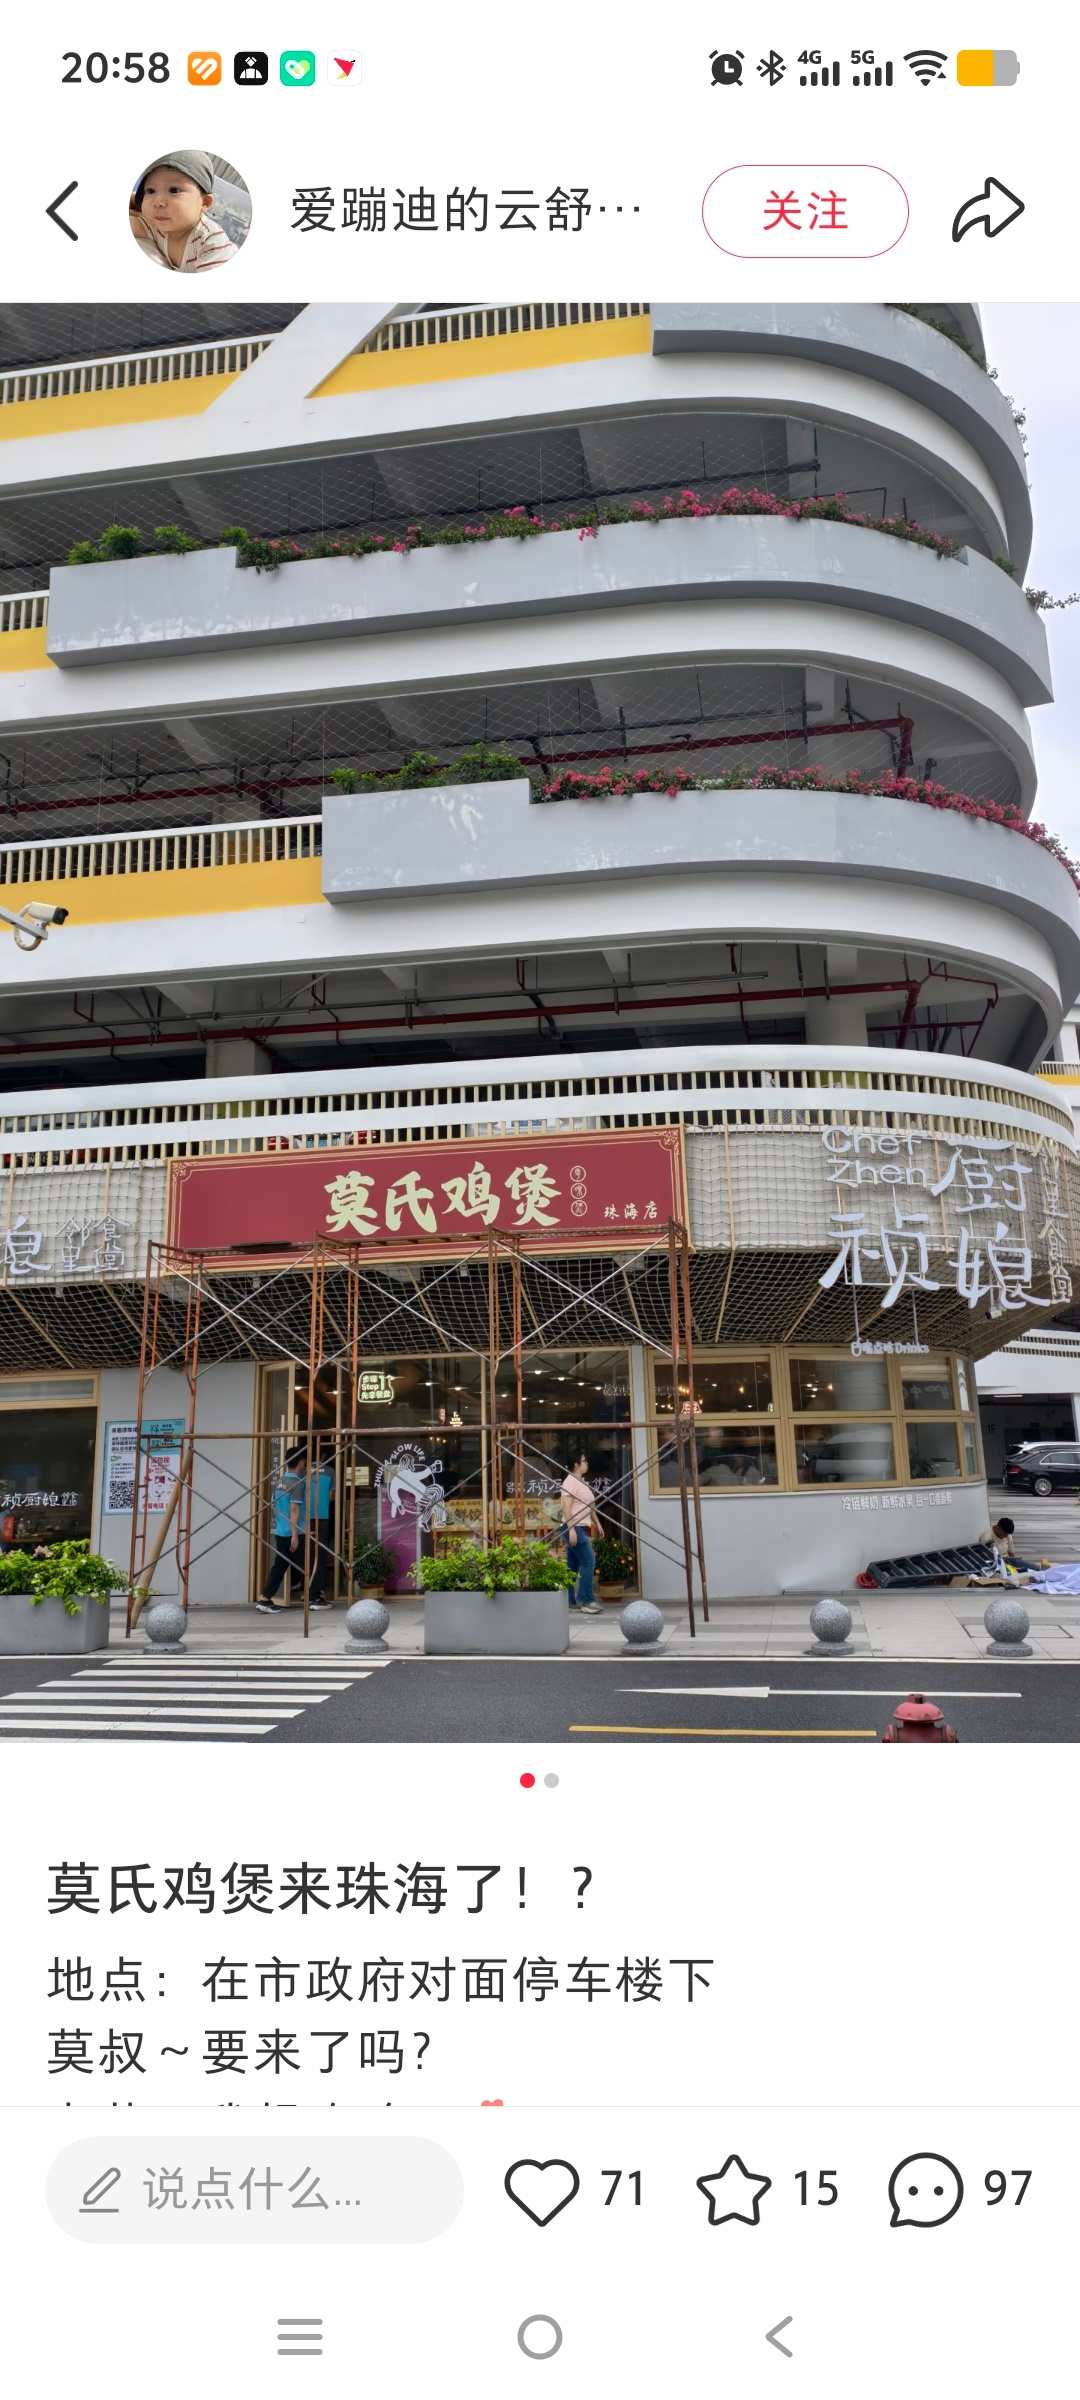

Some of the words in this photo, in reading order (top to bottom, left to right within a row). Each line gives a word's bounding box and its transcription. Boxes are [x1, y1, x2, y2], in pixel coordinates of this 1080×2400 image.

[822, 1125, 926, 1156] Chef
[826, 1158, 928, 1189] Zhen
[324, 1160, 562, 1237] 莫氏鸡煲
[604, 1200, 658, 1220] 珠海店
[361, 1383, 379, 1392] Step
[841, 1496, 879, 1511] 冷链鲜奶
[881, 1494, 914, 1510] 新鲜水果
